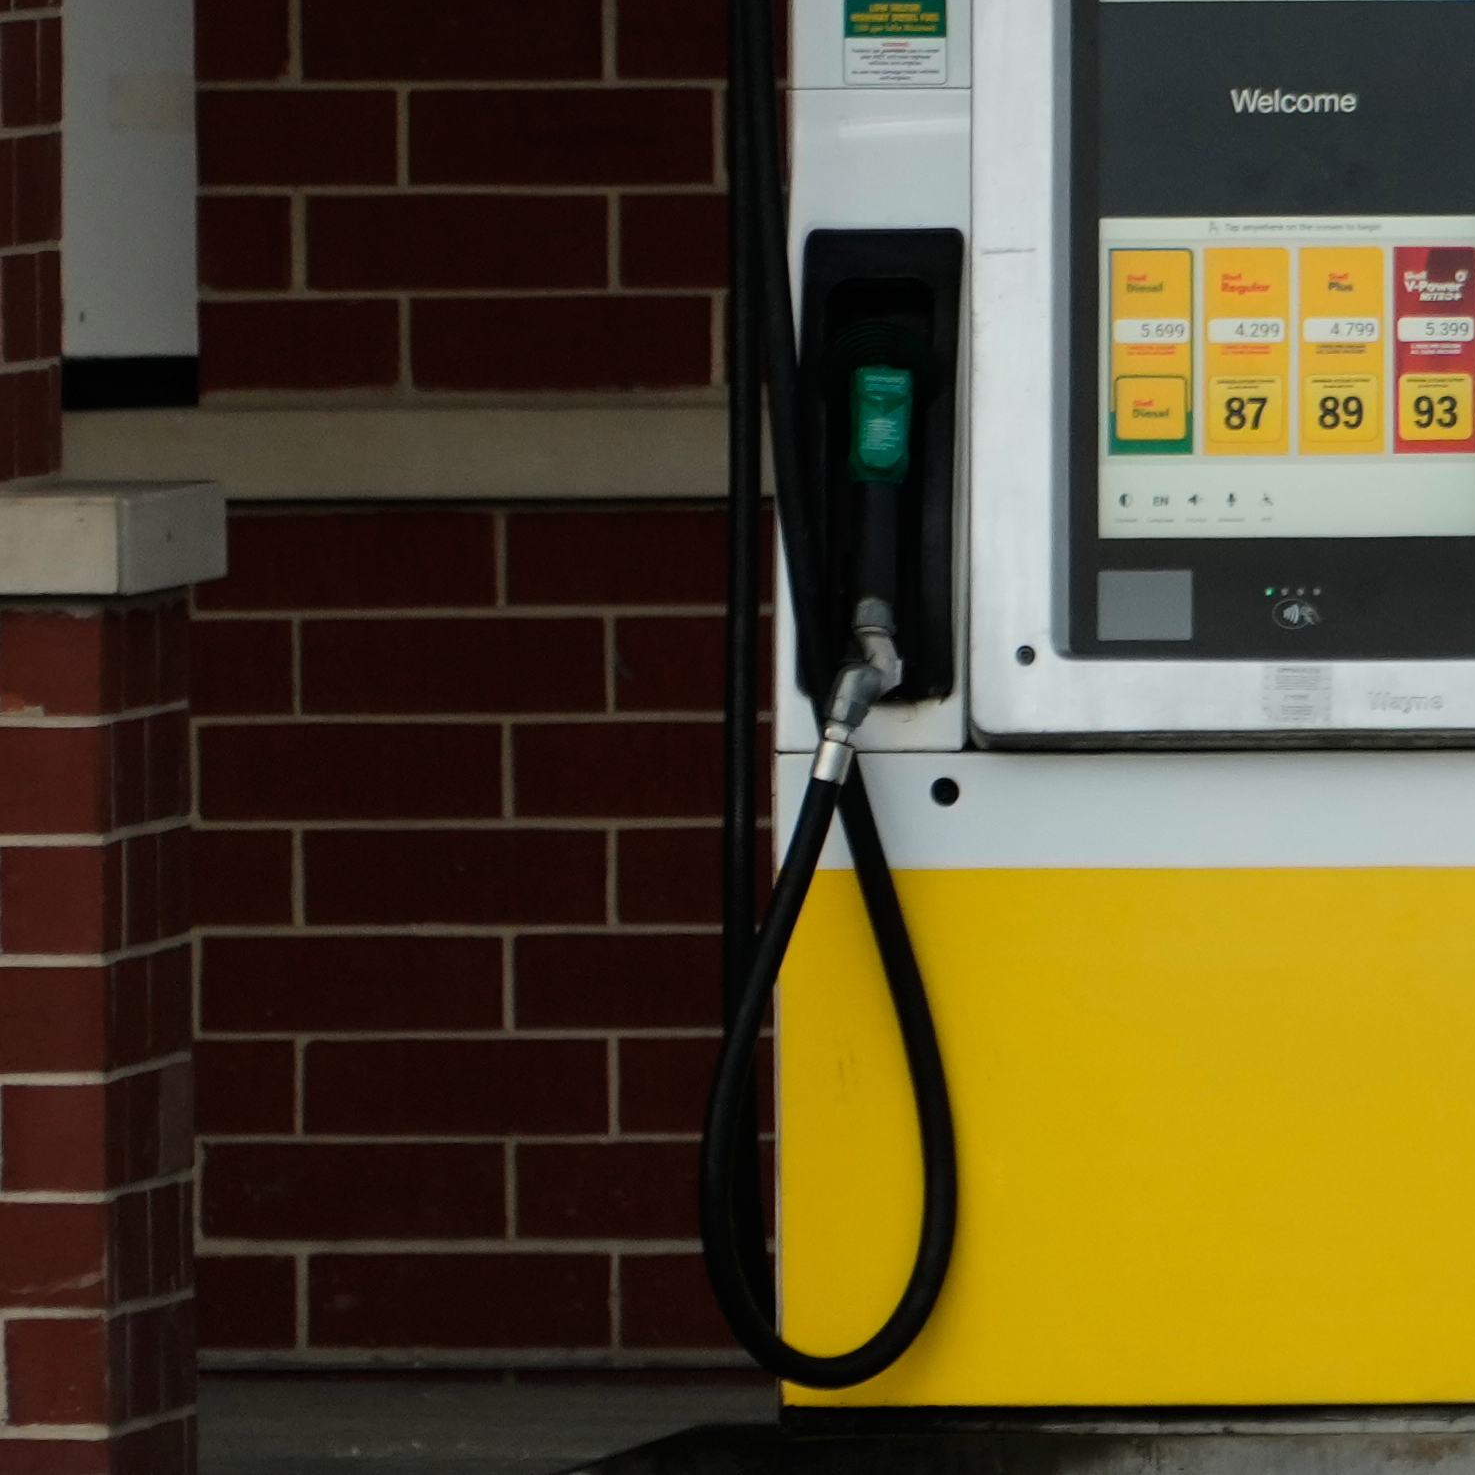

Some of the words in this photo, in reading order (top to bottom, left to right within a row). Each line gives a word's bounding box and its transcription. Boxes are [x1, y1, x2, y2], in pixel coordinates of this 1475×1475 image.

[1230, 89, 1357, 113] Welcome
[1328, 281, 1353, 293] Plus
[1141, 324, 1185, 338] 5.699
[1235, 324, 1280, 338] 4.299
[1330, 323, 1375, 338] 4.799
[1425, 322, 1470, 337] 5.399
[1224, 396, 1268, 430] 87
[1317, 395, 1364, 430] 89
[1413, 395, 1458, 429] 93
[1153, 496, 1169, 506] EN
